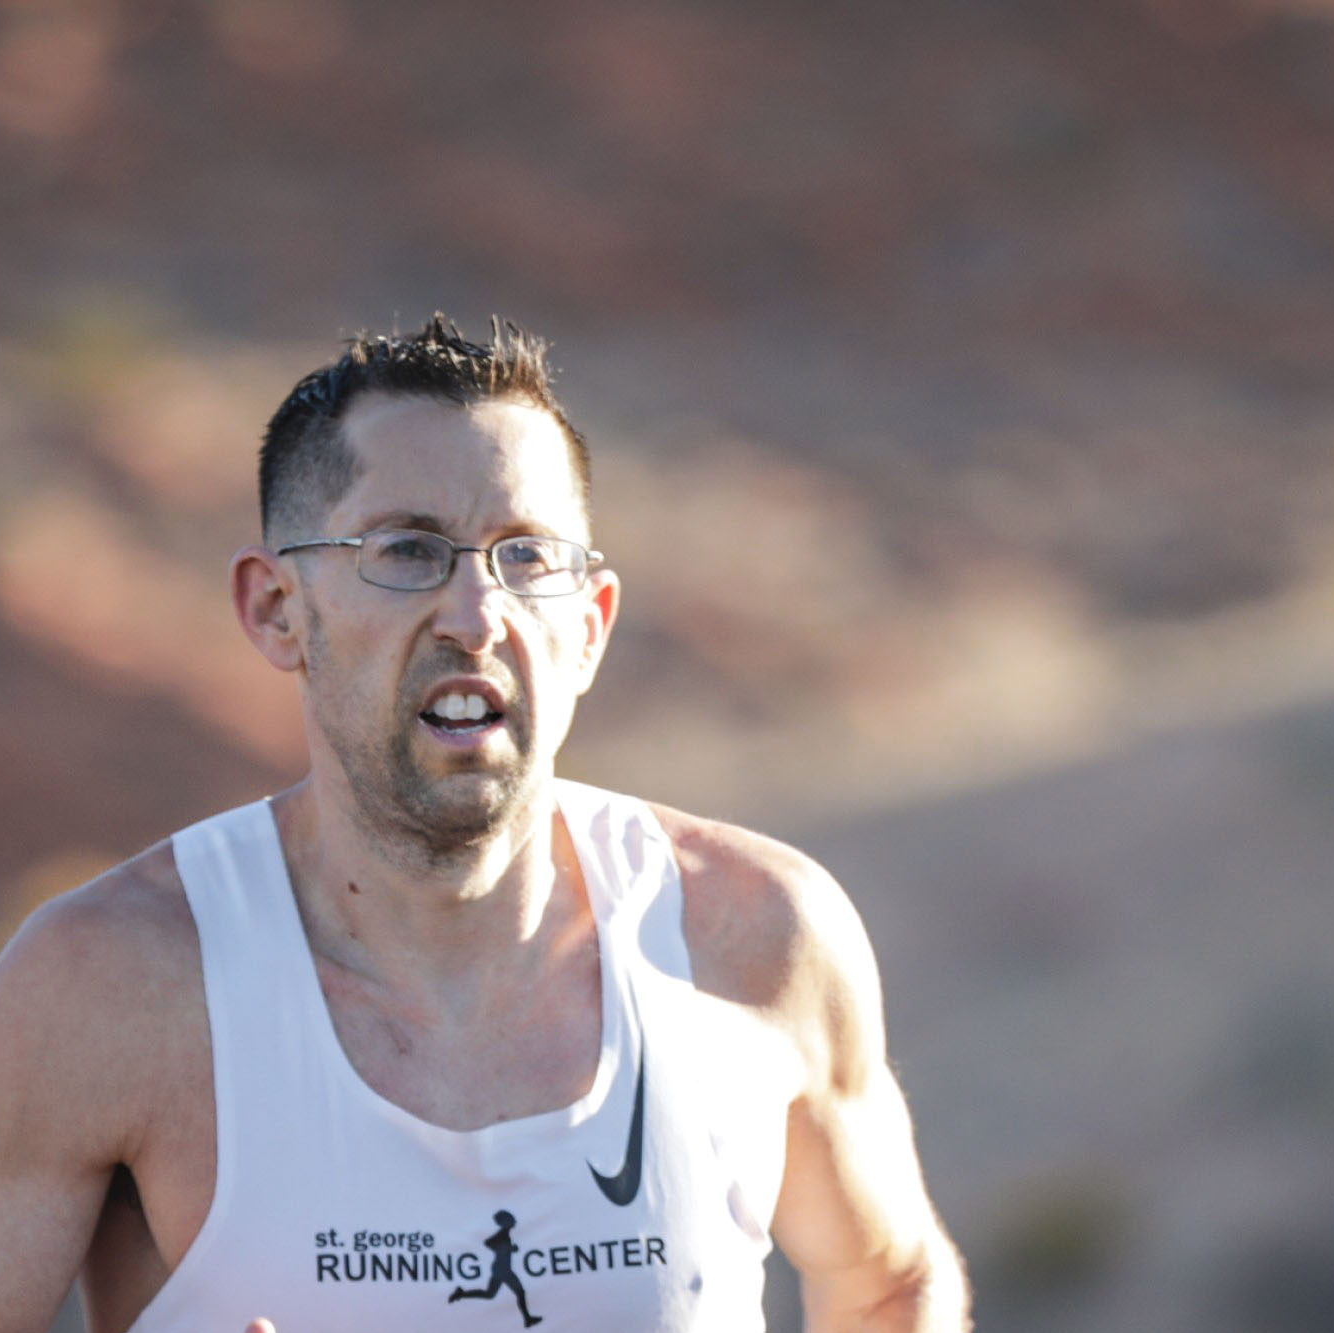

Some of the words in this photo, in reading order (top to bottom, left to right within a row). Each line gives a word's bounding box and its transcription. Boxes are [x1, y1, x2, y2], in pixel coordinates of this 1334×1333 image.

[315, 1230, 345, 1248] st.
[354, 1231, 435, 1253] george
[317, 1253, 482, 1282] RUNNING
[523, 1237, 667, 1277] CENTER
